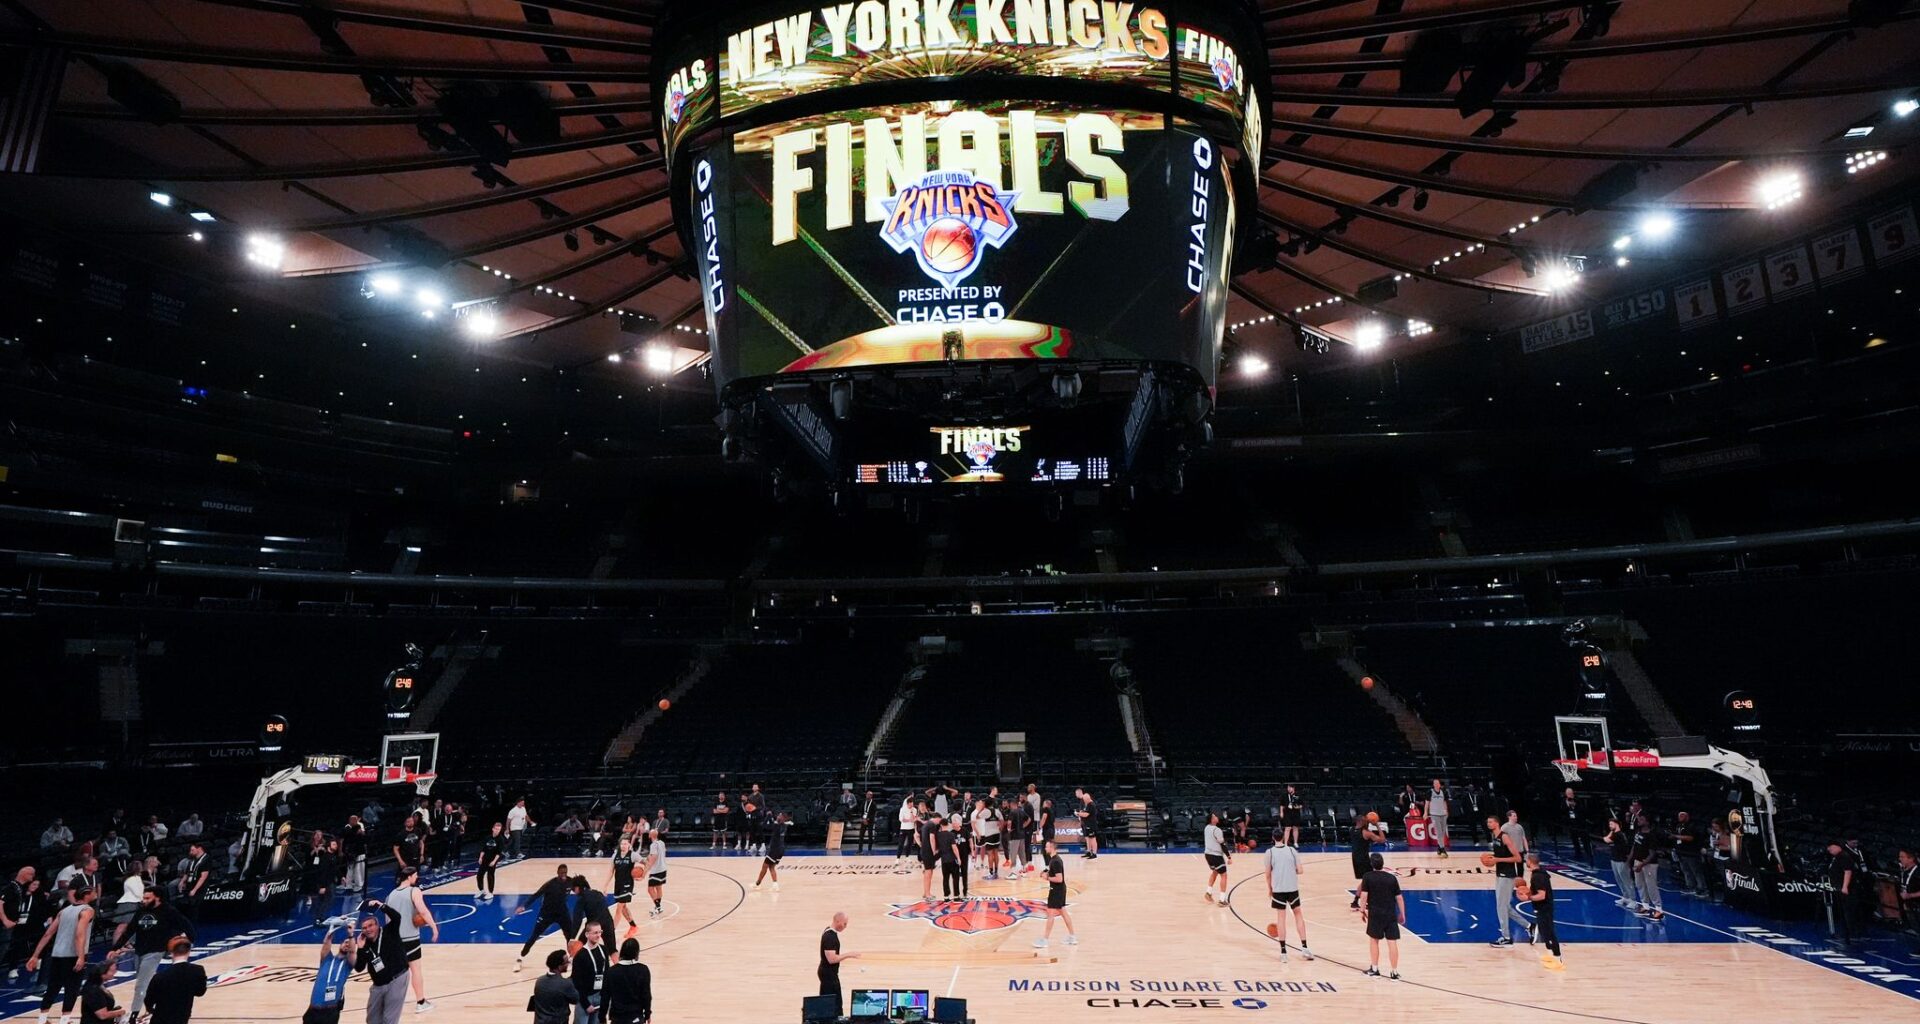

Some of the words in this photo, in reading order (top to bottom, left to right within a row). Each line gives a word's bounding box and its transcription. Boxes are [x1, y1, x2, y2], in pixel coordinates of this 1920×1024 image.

[726, 11, 811, 86] NEW
[822, 0, 961, 57] YORK
[973, 0, 1170, 60] KNICKS
[772, 110, 1130, 246] FINALS
[922, 174, 944, 187] NEW
[946, 173, 971, 184] YORK
[887, 181, 1010, 234] KNICKS
[1188, 170, 1210, 293] CHASE
[700, 192, 725, 313] CHASE
[1826, 244, 1847, 271] 7
[1780, 263, 1800, 287] 3
[899, 286, 980, 302] PRESENTED
[983, 286, 1002, 299] BY
[1735, 278, 1753, 302] 2
[896, 305, 979, 325] CHASE
[1628, 288, 1666, 320] 150
[1567, 312, 1591, 335] 15
[940, 428, 1021, 455] FINALS
[209, 748, 255, 758] ULTRA
[1055, 828, 1079, 836] HASE
[1410, 823, 1426, 840] G
[1730, 872, 1760, 891] Finals
[1727, 926, 1811, 945] NEW
[1802, 950, 1920, 982] YORK
[1008, 979, 1120, 992] MADISON
[1129, 979, 1228, 992] SQUARE
[1233, 979, 1338, 993] GARDEN
[1086, 998, 1225, 1008] CHASE
